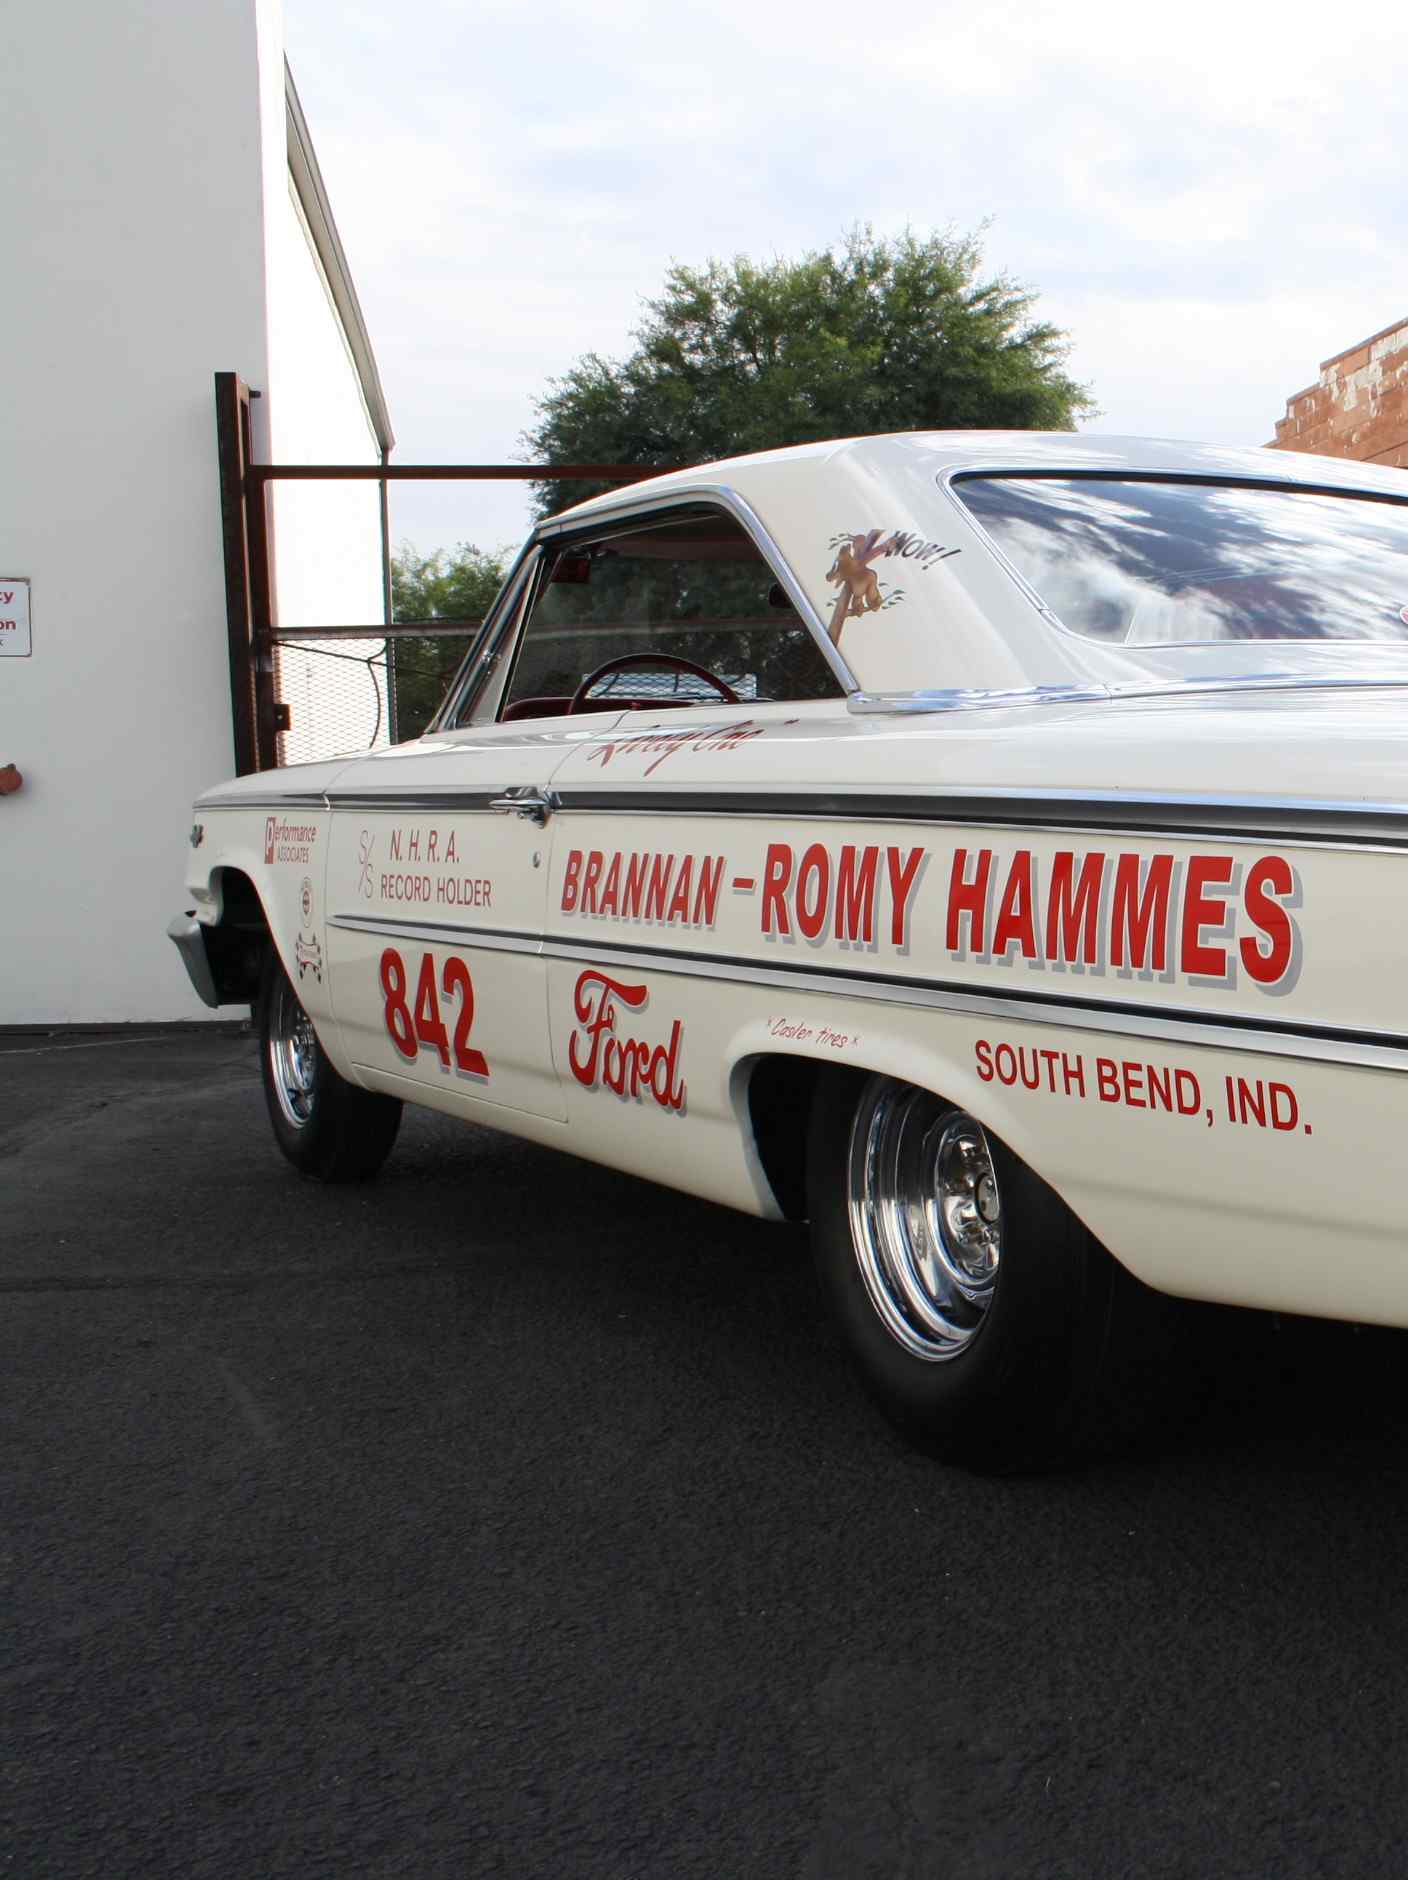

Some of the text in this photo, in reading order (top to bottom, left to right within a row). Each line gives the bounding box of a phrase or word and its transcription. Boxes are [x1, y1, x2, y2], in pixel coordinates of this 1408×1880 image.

[380, 874, 492, 907] RECORD HOLDER
[946, 847, 1300, 990] HAMMES
[380, 947, 491, 1083] 842
[568, 969, 688, 1114] Ford
[975, 1039, 1313, 1135] SOUTH BEND, IND.
